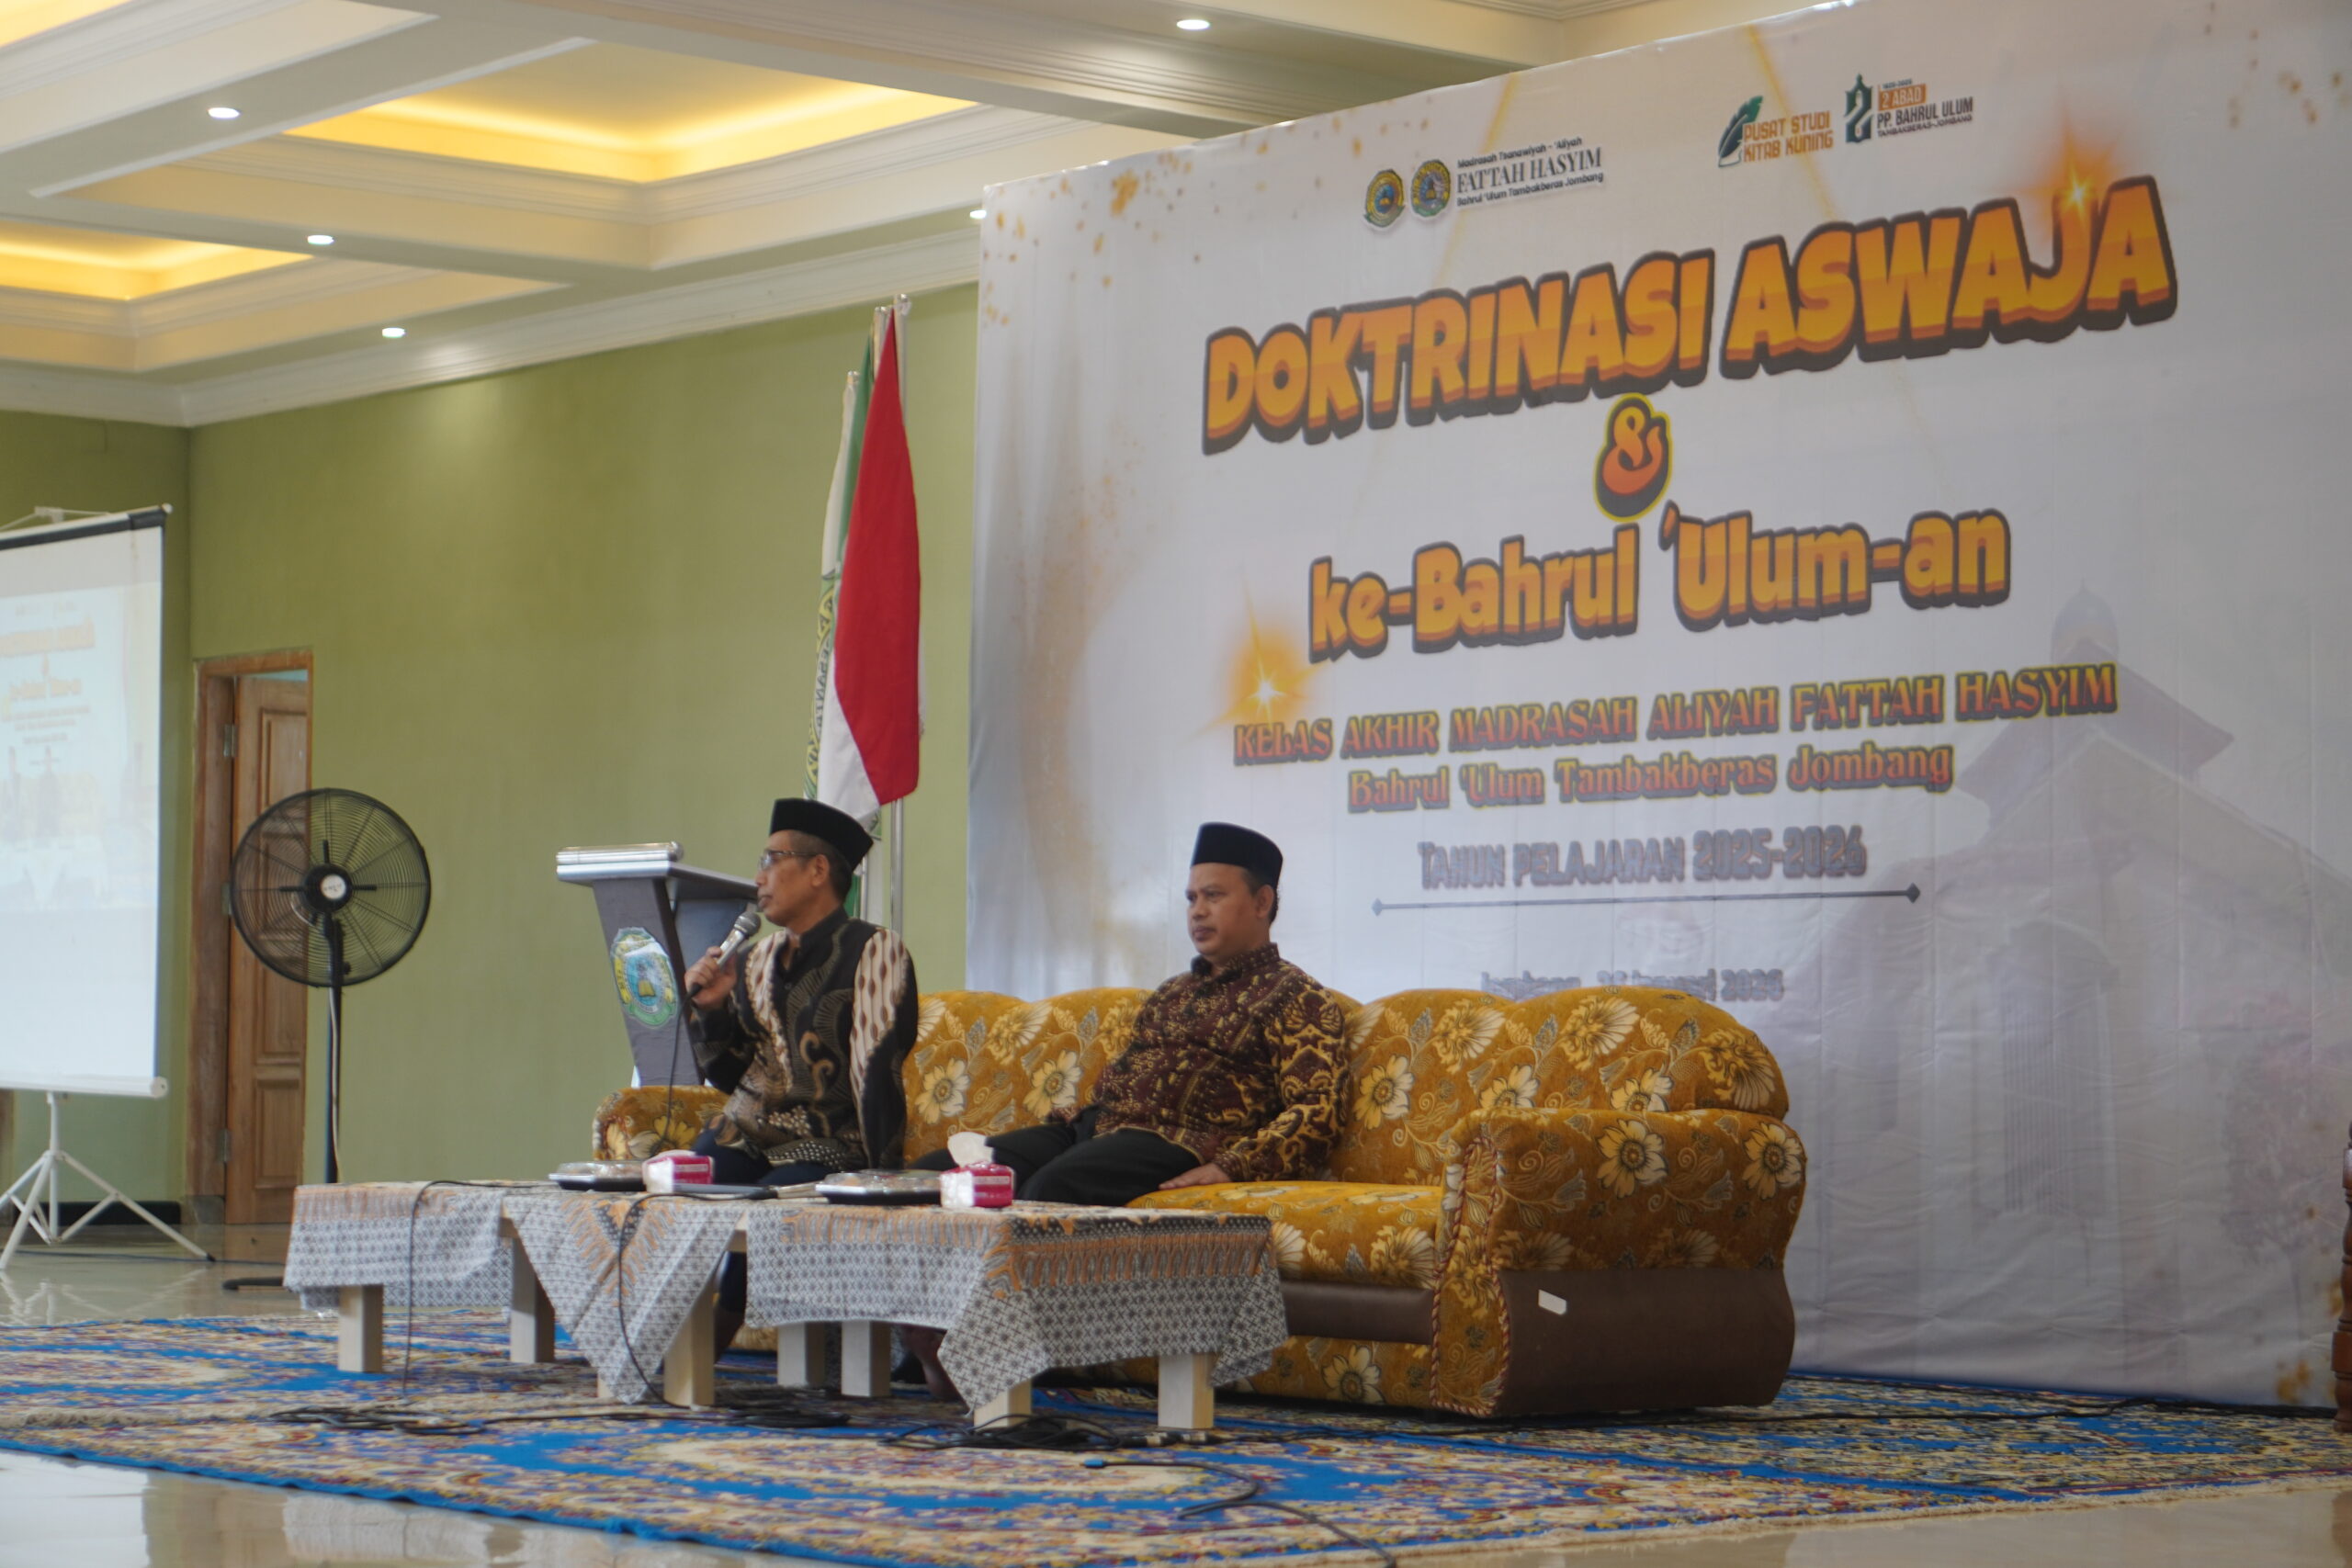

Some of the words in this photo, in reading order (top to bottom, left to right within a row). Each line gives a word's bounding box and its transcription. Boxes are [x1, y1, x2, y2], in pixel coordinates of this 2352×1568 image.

[1877, 111, 1894, 130] PP.
[1895, 104, 1939, 127] BAHRUL
[1942, 96, 1973, 119] ULUM
[1882, 93, 1889, 108] 2
[1892, 86, 1922, 107] ABAD
[1743, 118, 1786, 142] PUSAT
[1792, 110, 1831, 131] STUDI
[1743, 139, 1781, 163] KITAB
[1785, 130, 1834, 155] KUNING
[1457, 153, 1497, 169] Madrasah
[1498, 144, 1546, 162] Tsanawiyah
[1457, 162, 1525, 194] FATTAH
[1530, 147, 1601, 180] HASYIM
[1457, 194, 1483, 207] Bahrul
[1509, 178, 1563, 197] Tambakberas
[1565, 172, 1604, 186] Jombang
[1202, 248, 1715, 456] DOKTRINASI
[1719, 175, 2177, 379] ASWAJA
[1597, 396, 1670, 516] &
[1309, 522, 1640, 664] ke-Bahrul
[1658, 499, 2010, 633] 'Ulum-an
[1234, 717, 1332, 766] KELAS
[1340, 710, 1440, 759] AKHIR
[1448, 695, 1637, 751] MADRASAH
[1647, 686, 1779, 739] ALIYAH
[1791, 674, 1945, 731] FATTAH
[1955, 662, 2118, 722] HASYIM
[1348, 765, 1450, 813] Bahrul
[1555, 752, 1777, 804] Tambakberas
[1787, 739, 1954, 793] Jombang
[1513, 837, 1685, 887] PELAJARAN
[1692, 824, 1868, 881] 2025-2026
